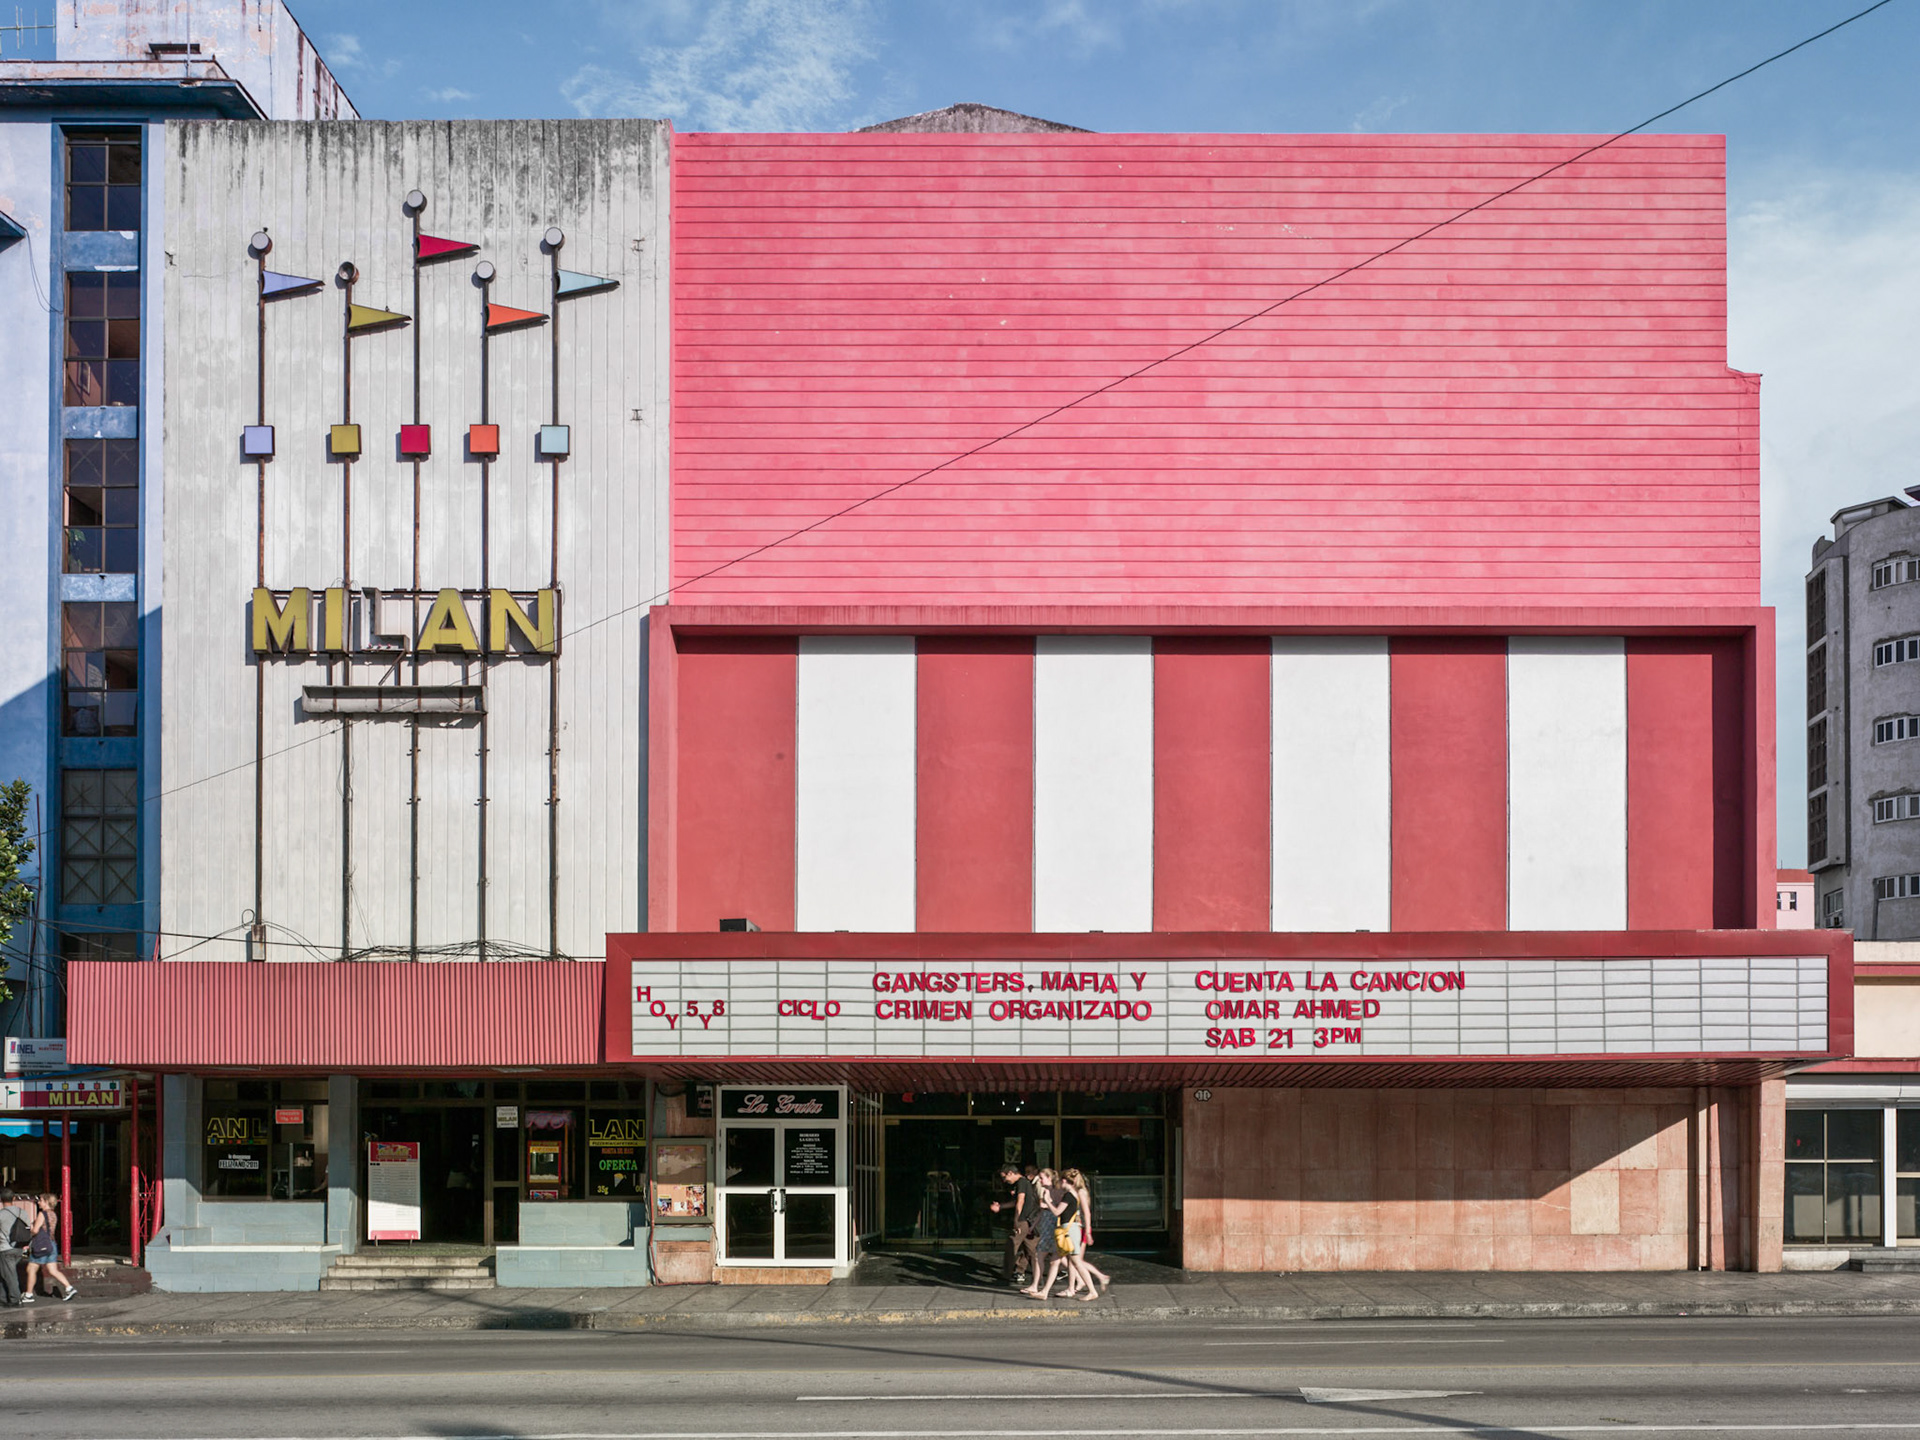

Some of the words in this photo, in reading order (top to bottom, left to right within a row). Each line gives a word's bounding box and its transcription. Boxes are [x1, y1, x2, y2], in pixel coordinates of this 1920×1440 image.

[253, 587, 561, 654] MILAN
[1041, 971, 1118, 993] MAFIA
[1132, 972, 1147, 991] Y
[1195, 970, 1294, 992] CUENTA
[1305, 971, 1338, 991] LA
[1350, 970, 1465, 992] CANCION
[778, 1000, 841, 1020] CICLO
[876, 1000, 972, 1021] CRIMEN
[989, 1000, 1152, 1021] ORGANIZADO
[1205, 1000, 1280, 1020] OMAR
[1293, 999, 1381, 1020] AHMED
[1205, 1027, 1256, 1048] SAB
[1268, 1028, 1294, 1048] 21
[1313, 1027, 1362, 1048] 3PM
[49, 1092, 114, 1105] MILAN
[737, 1094, 769, 1113] La
[775, 1095, 824, 1113] Gruta
[590, 1118, 645, 1140] LAN
[599, 1159, 638, 1171] OFERTA
